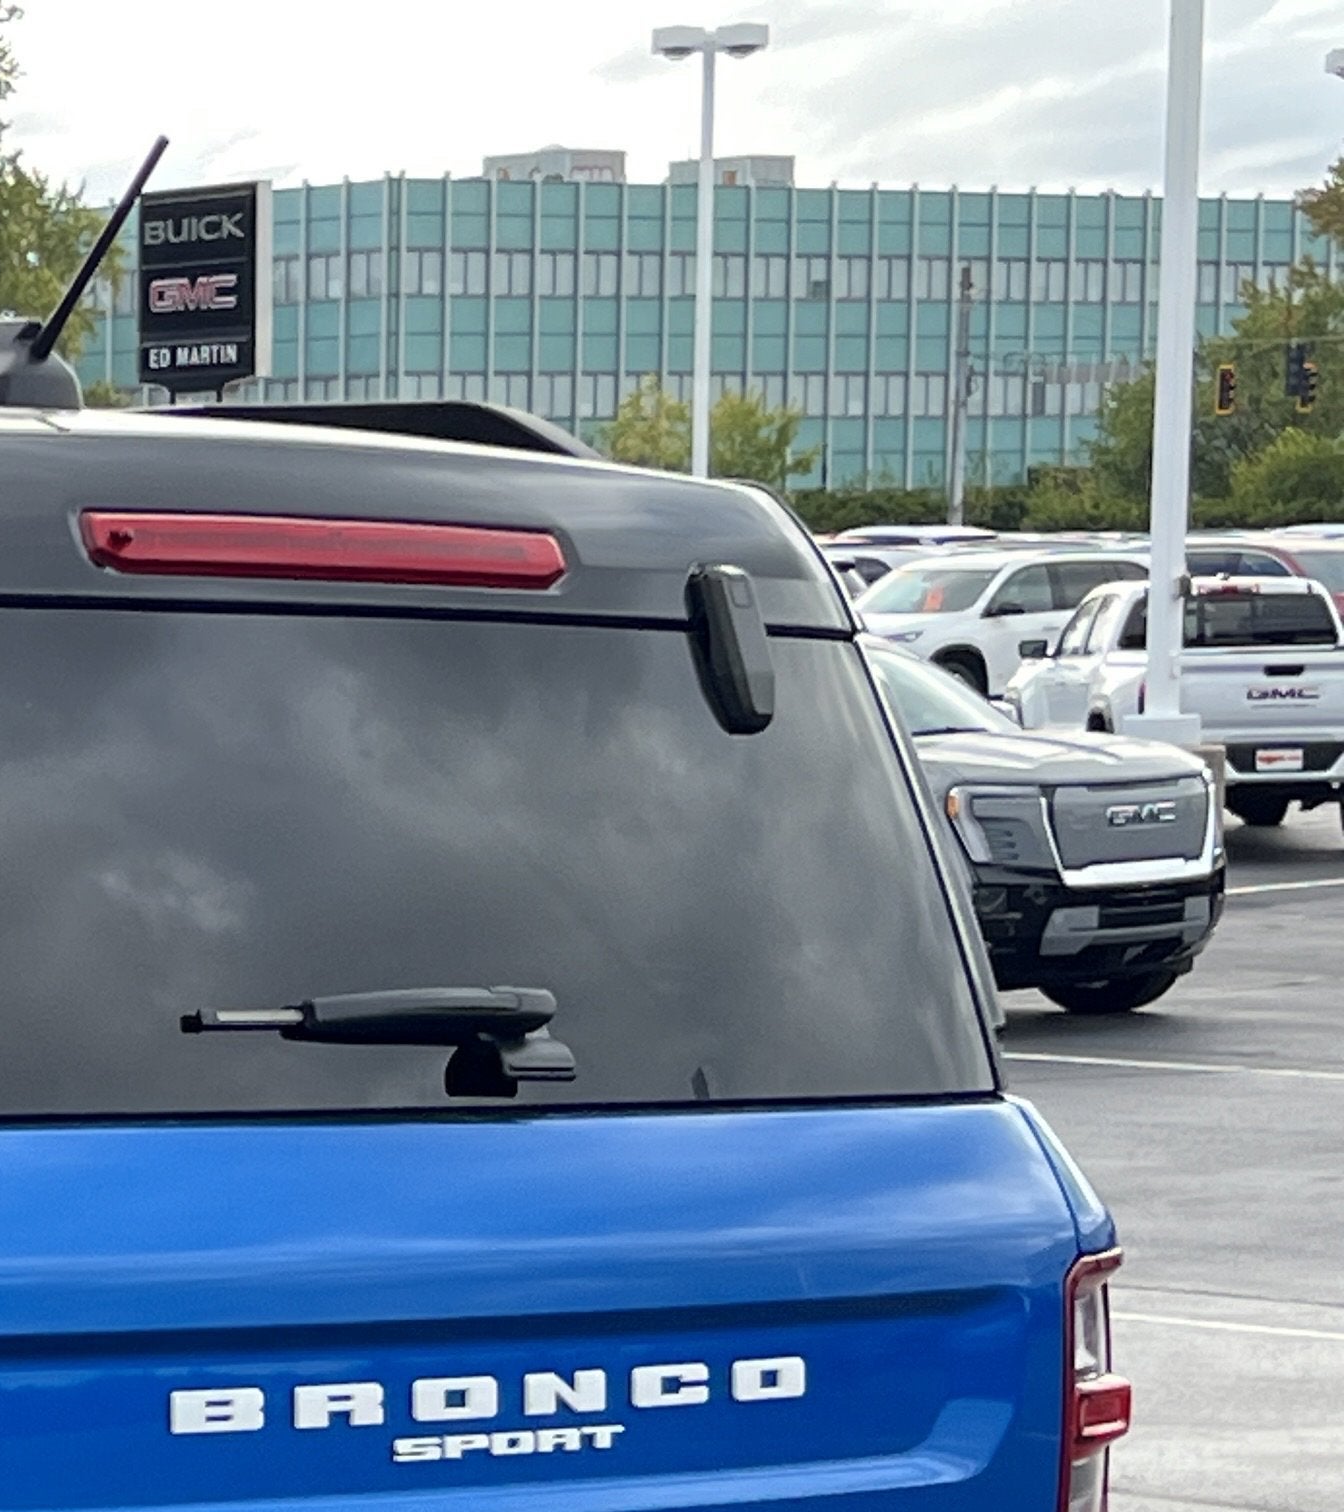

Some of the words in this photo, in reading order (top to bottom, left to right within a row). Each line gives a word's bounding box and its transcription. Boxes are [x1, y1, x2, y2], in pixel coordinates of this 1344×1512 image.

[143, 213, 245, 245] BUICK
[149, 273, 238, 313] GMC
[148, 348, 171, 369] ED
[175, 344, 238, 367] MARTIN
[1106, 801, 1176, 826] GMC
[170, 1356, 806, 1434] BRONCO
[392, 1424, 625, 1463] SPORT
